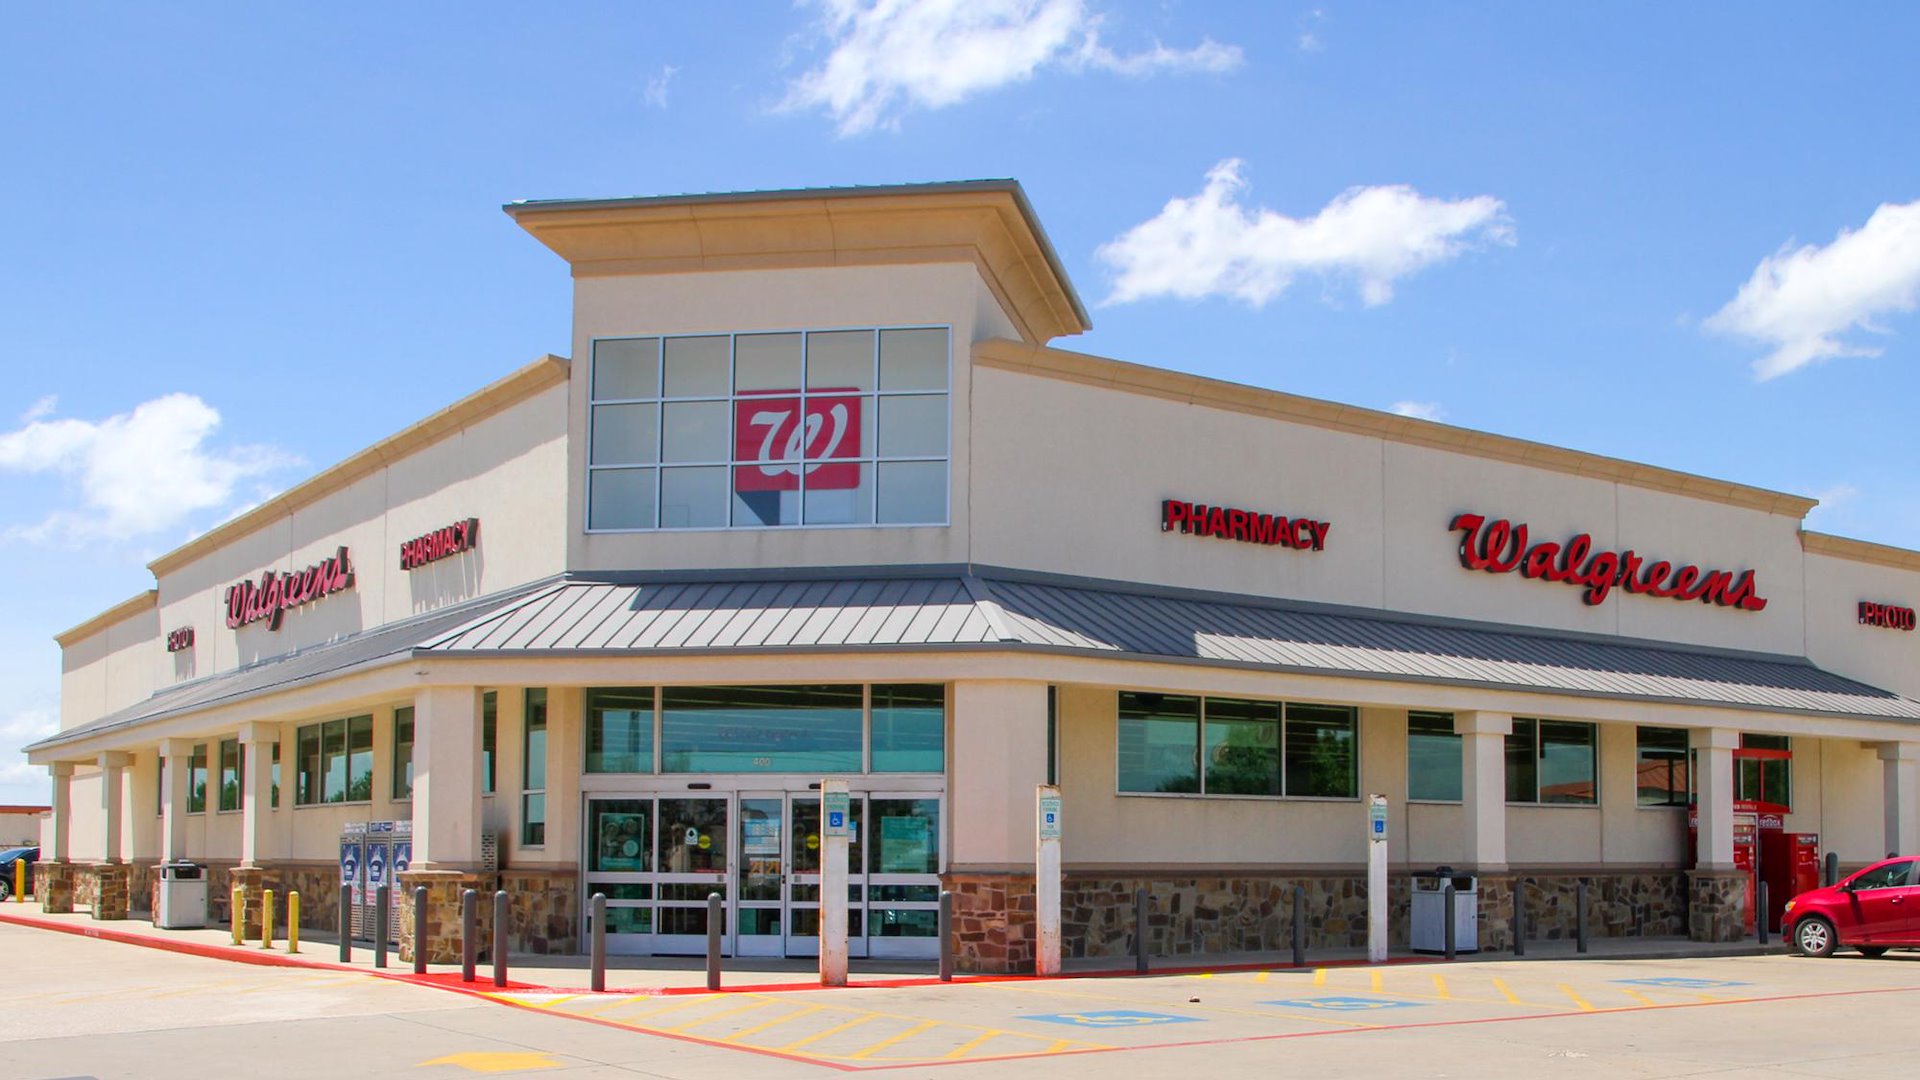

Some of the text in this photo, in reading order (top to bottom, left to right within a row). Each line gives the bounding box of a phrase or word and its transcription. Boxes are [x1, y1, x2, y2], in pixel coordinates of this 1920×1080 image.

[400, 518, 478, 570] PHARMACY
[1162, 500, 1330, 551] PHARMACY
[225, 546, 354, 631] Walgreens
[1448, 514, 1767, 611] Walgreens
[1858, 601, 1916, 631] PHOTO
